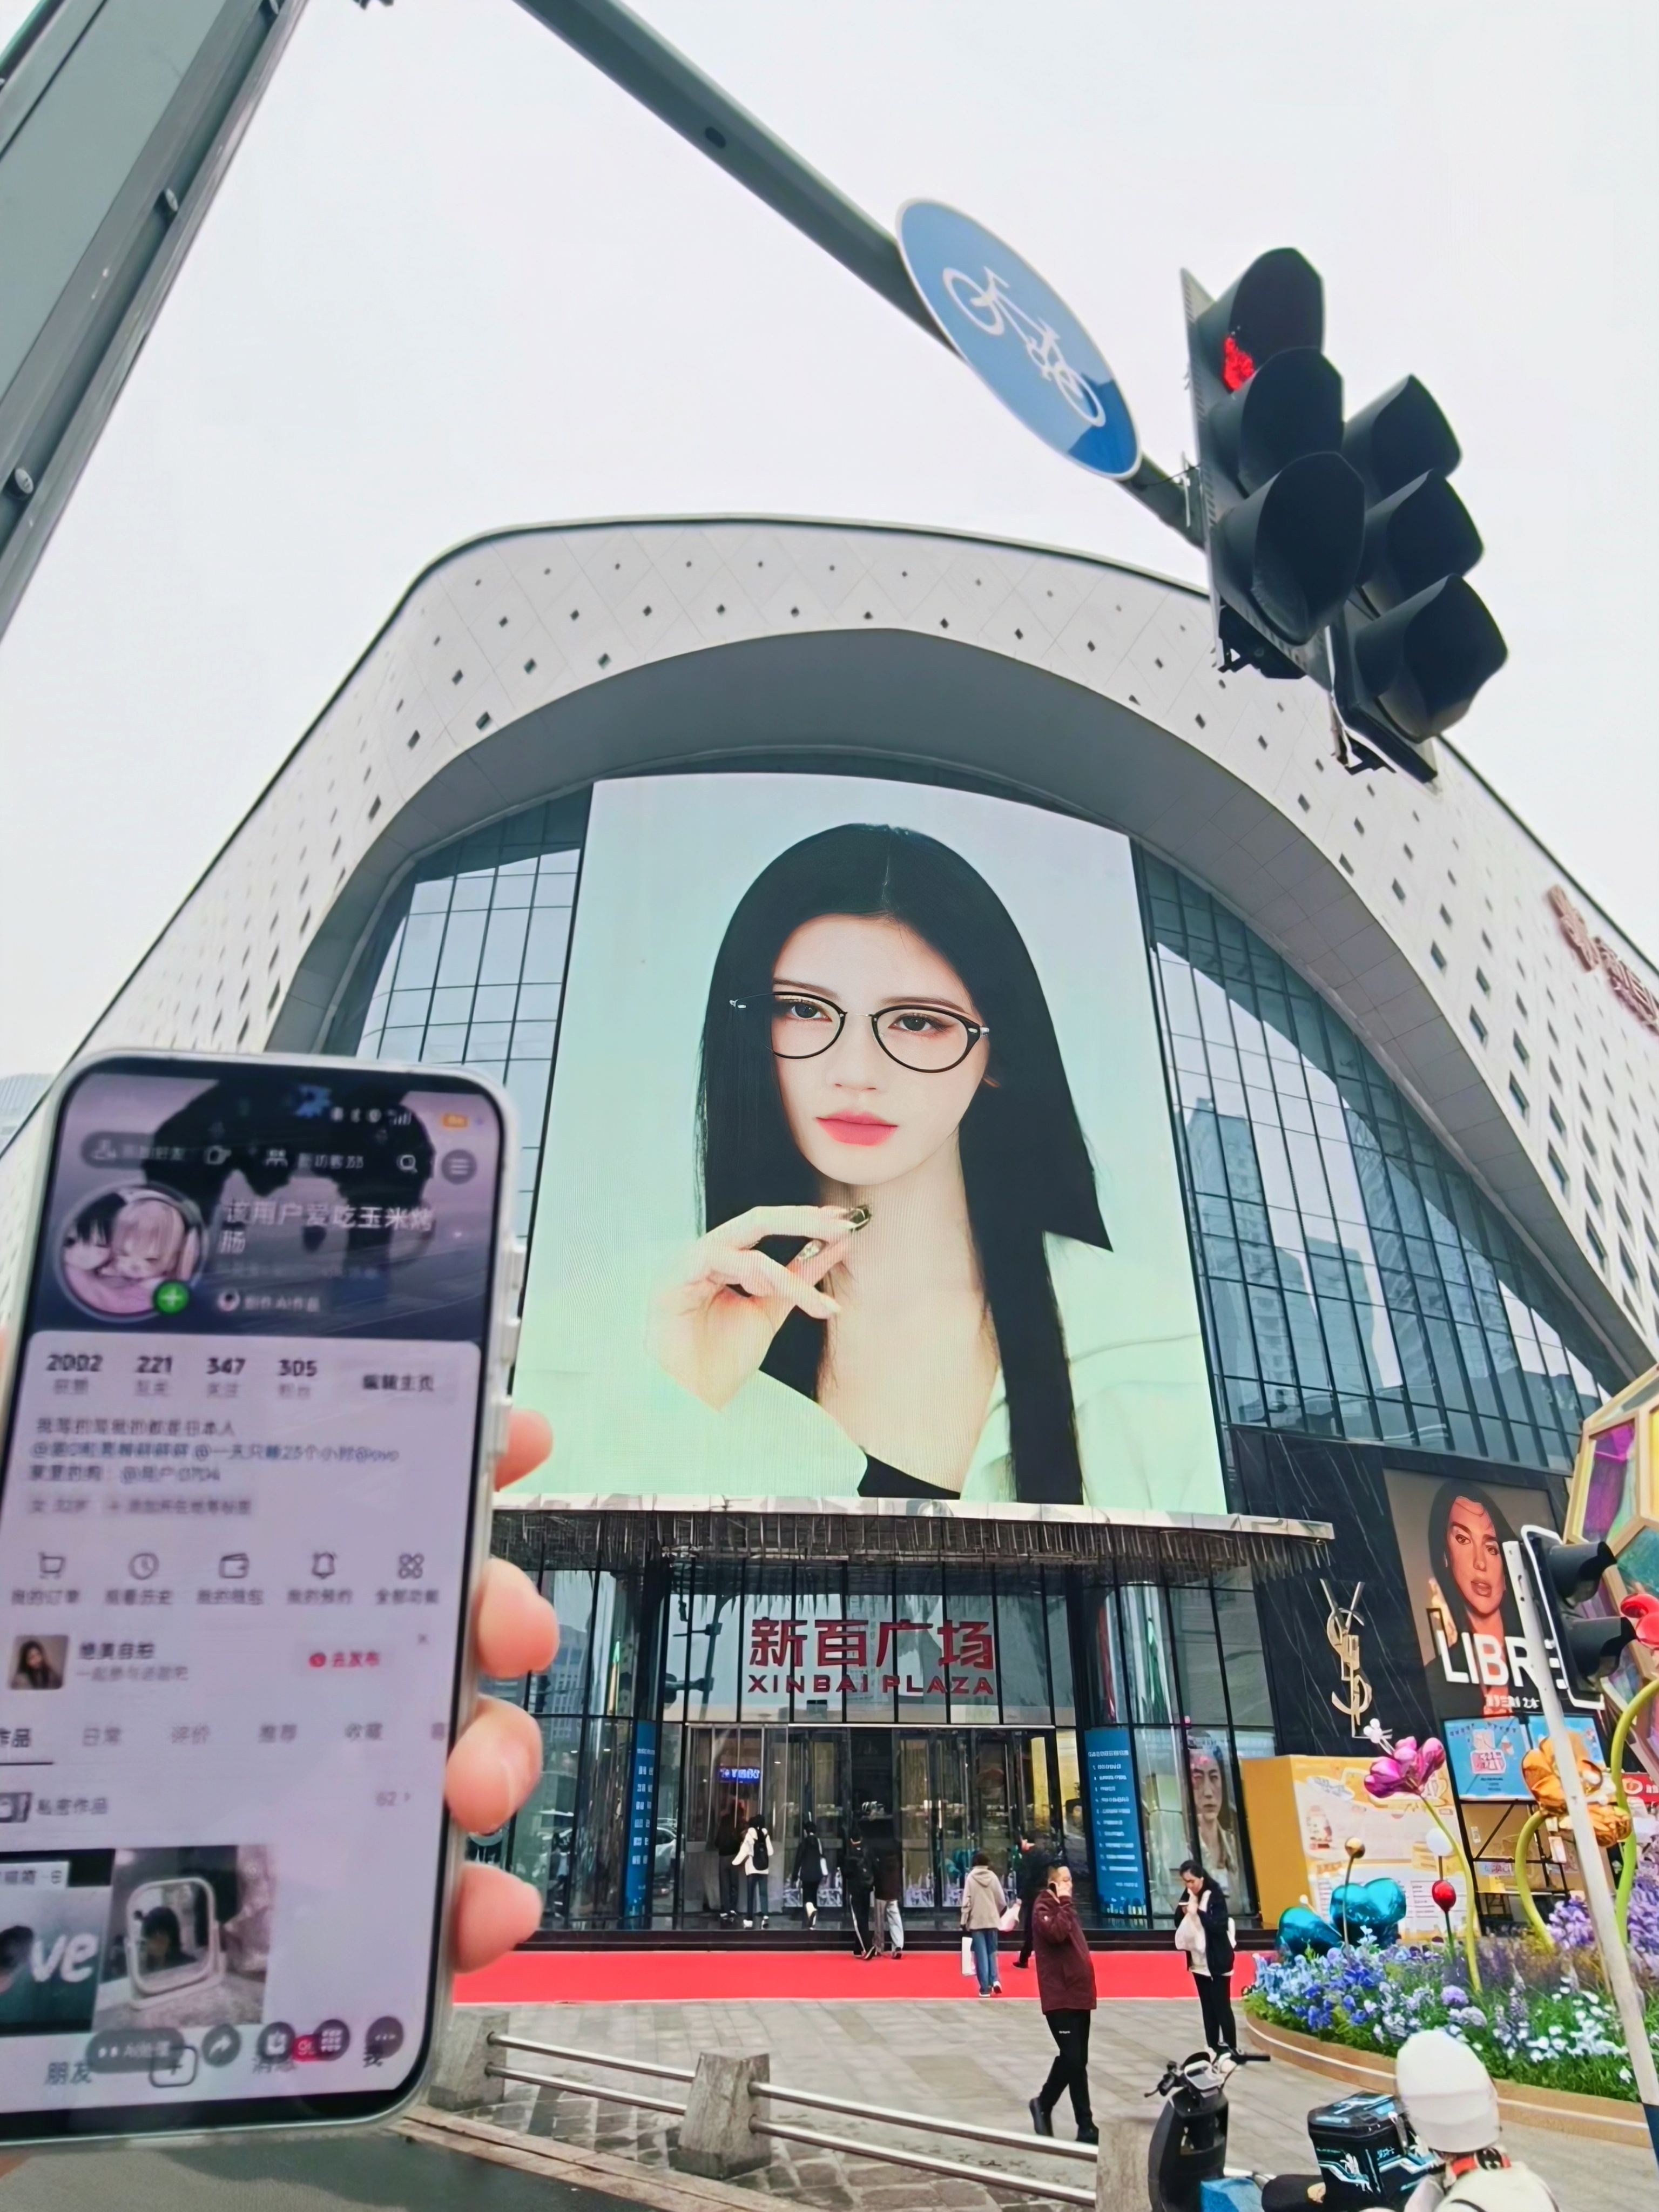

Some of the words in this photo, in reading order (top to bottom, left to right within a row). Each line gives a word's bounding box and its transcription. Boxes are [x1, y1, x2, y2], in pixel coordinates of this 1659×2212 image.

[46, 1354, 103, 1372] 2002
[136, 1355, 172, 1373] 221
[206, 1357, 246, 1374] 347
[277, 1359, 318, 1377] 305
[750, 1617, 994, 1669] 新百广场
[748, 1675, 868, 1693] XINBAI
[882, 1675, 994, 1695] PLAZA
